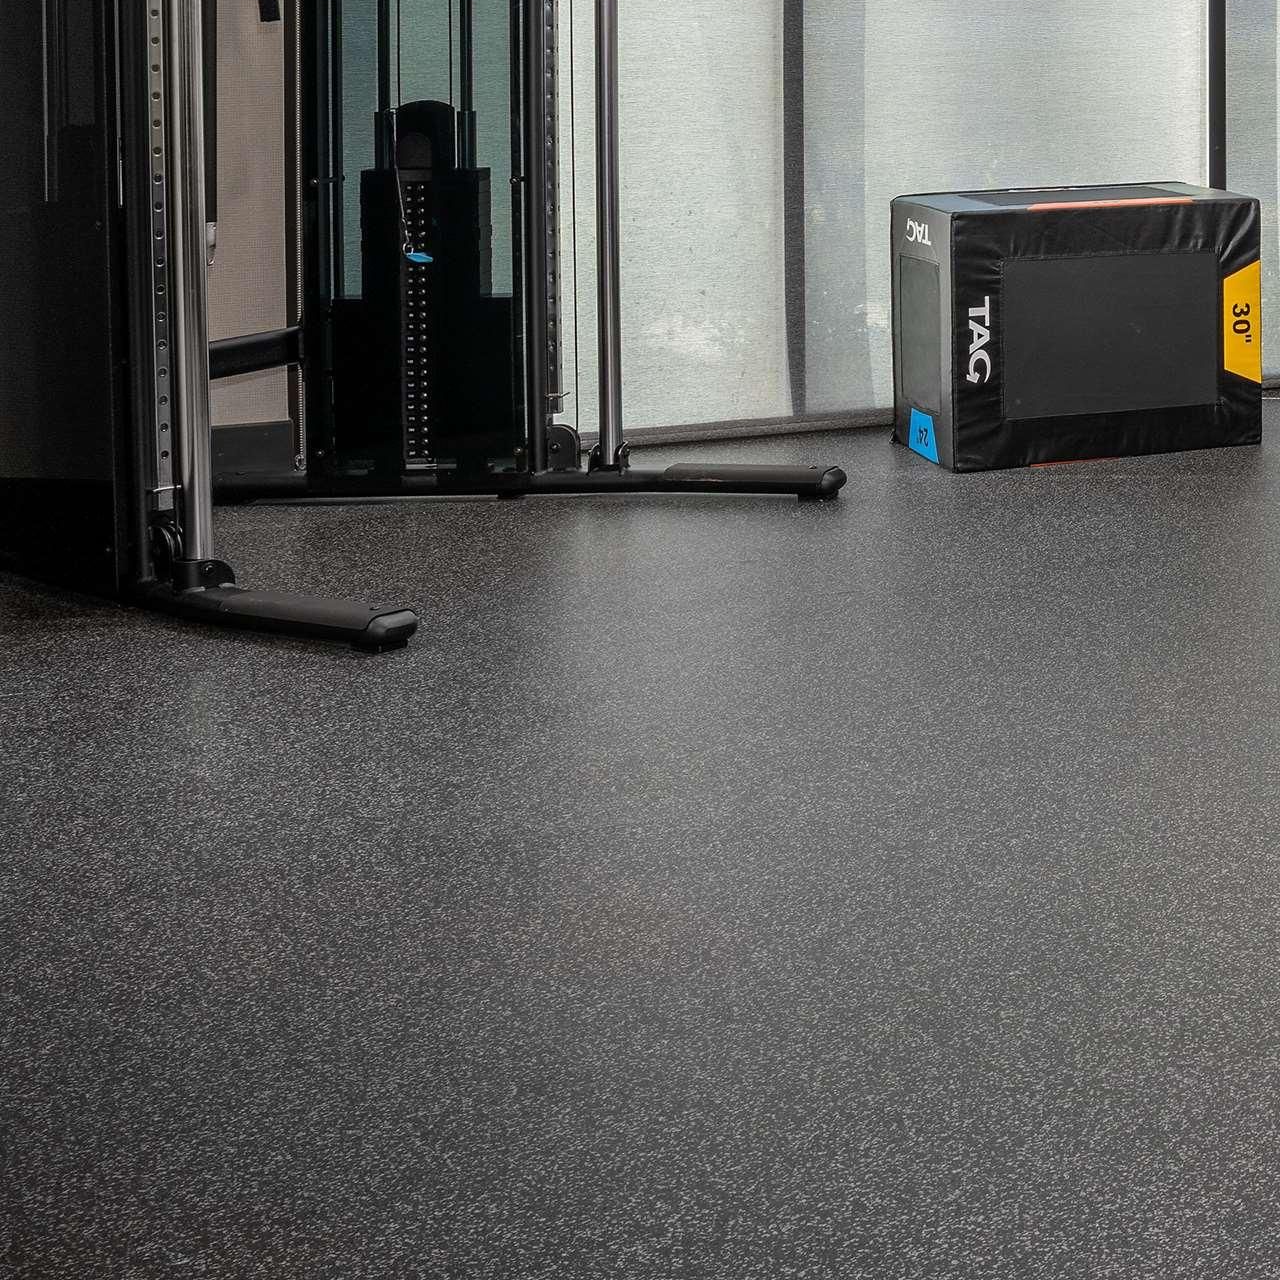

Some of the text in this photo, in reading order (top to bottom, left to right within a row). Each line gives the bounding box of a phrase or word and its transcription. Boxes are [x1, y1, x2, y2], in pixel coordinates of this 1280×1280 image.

[905, 217, 932, 246] TAG
[966, 295, 992, 384] TAG
[1232, 302, 1252, 343] 30"
